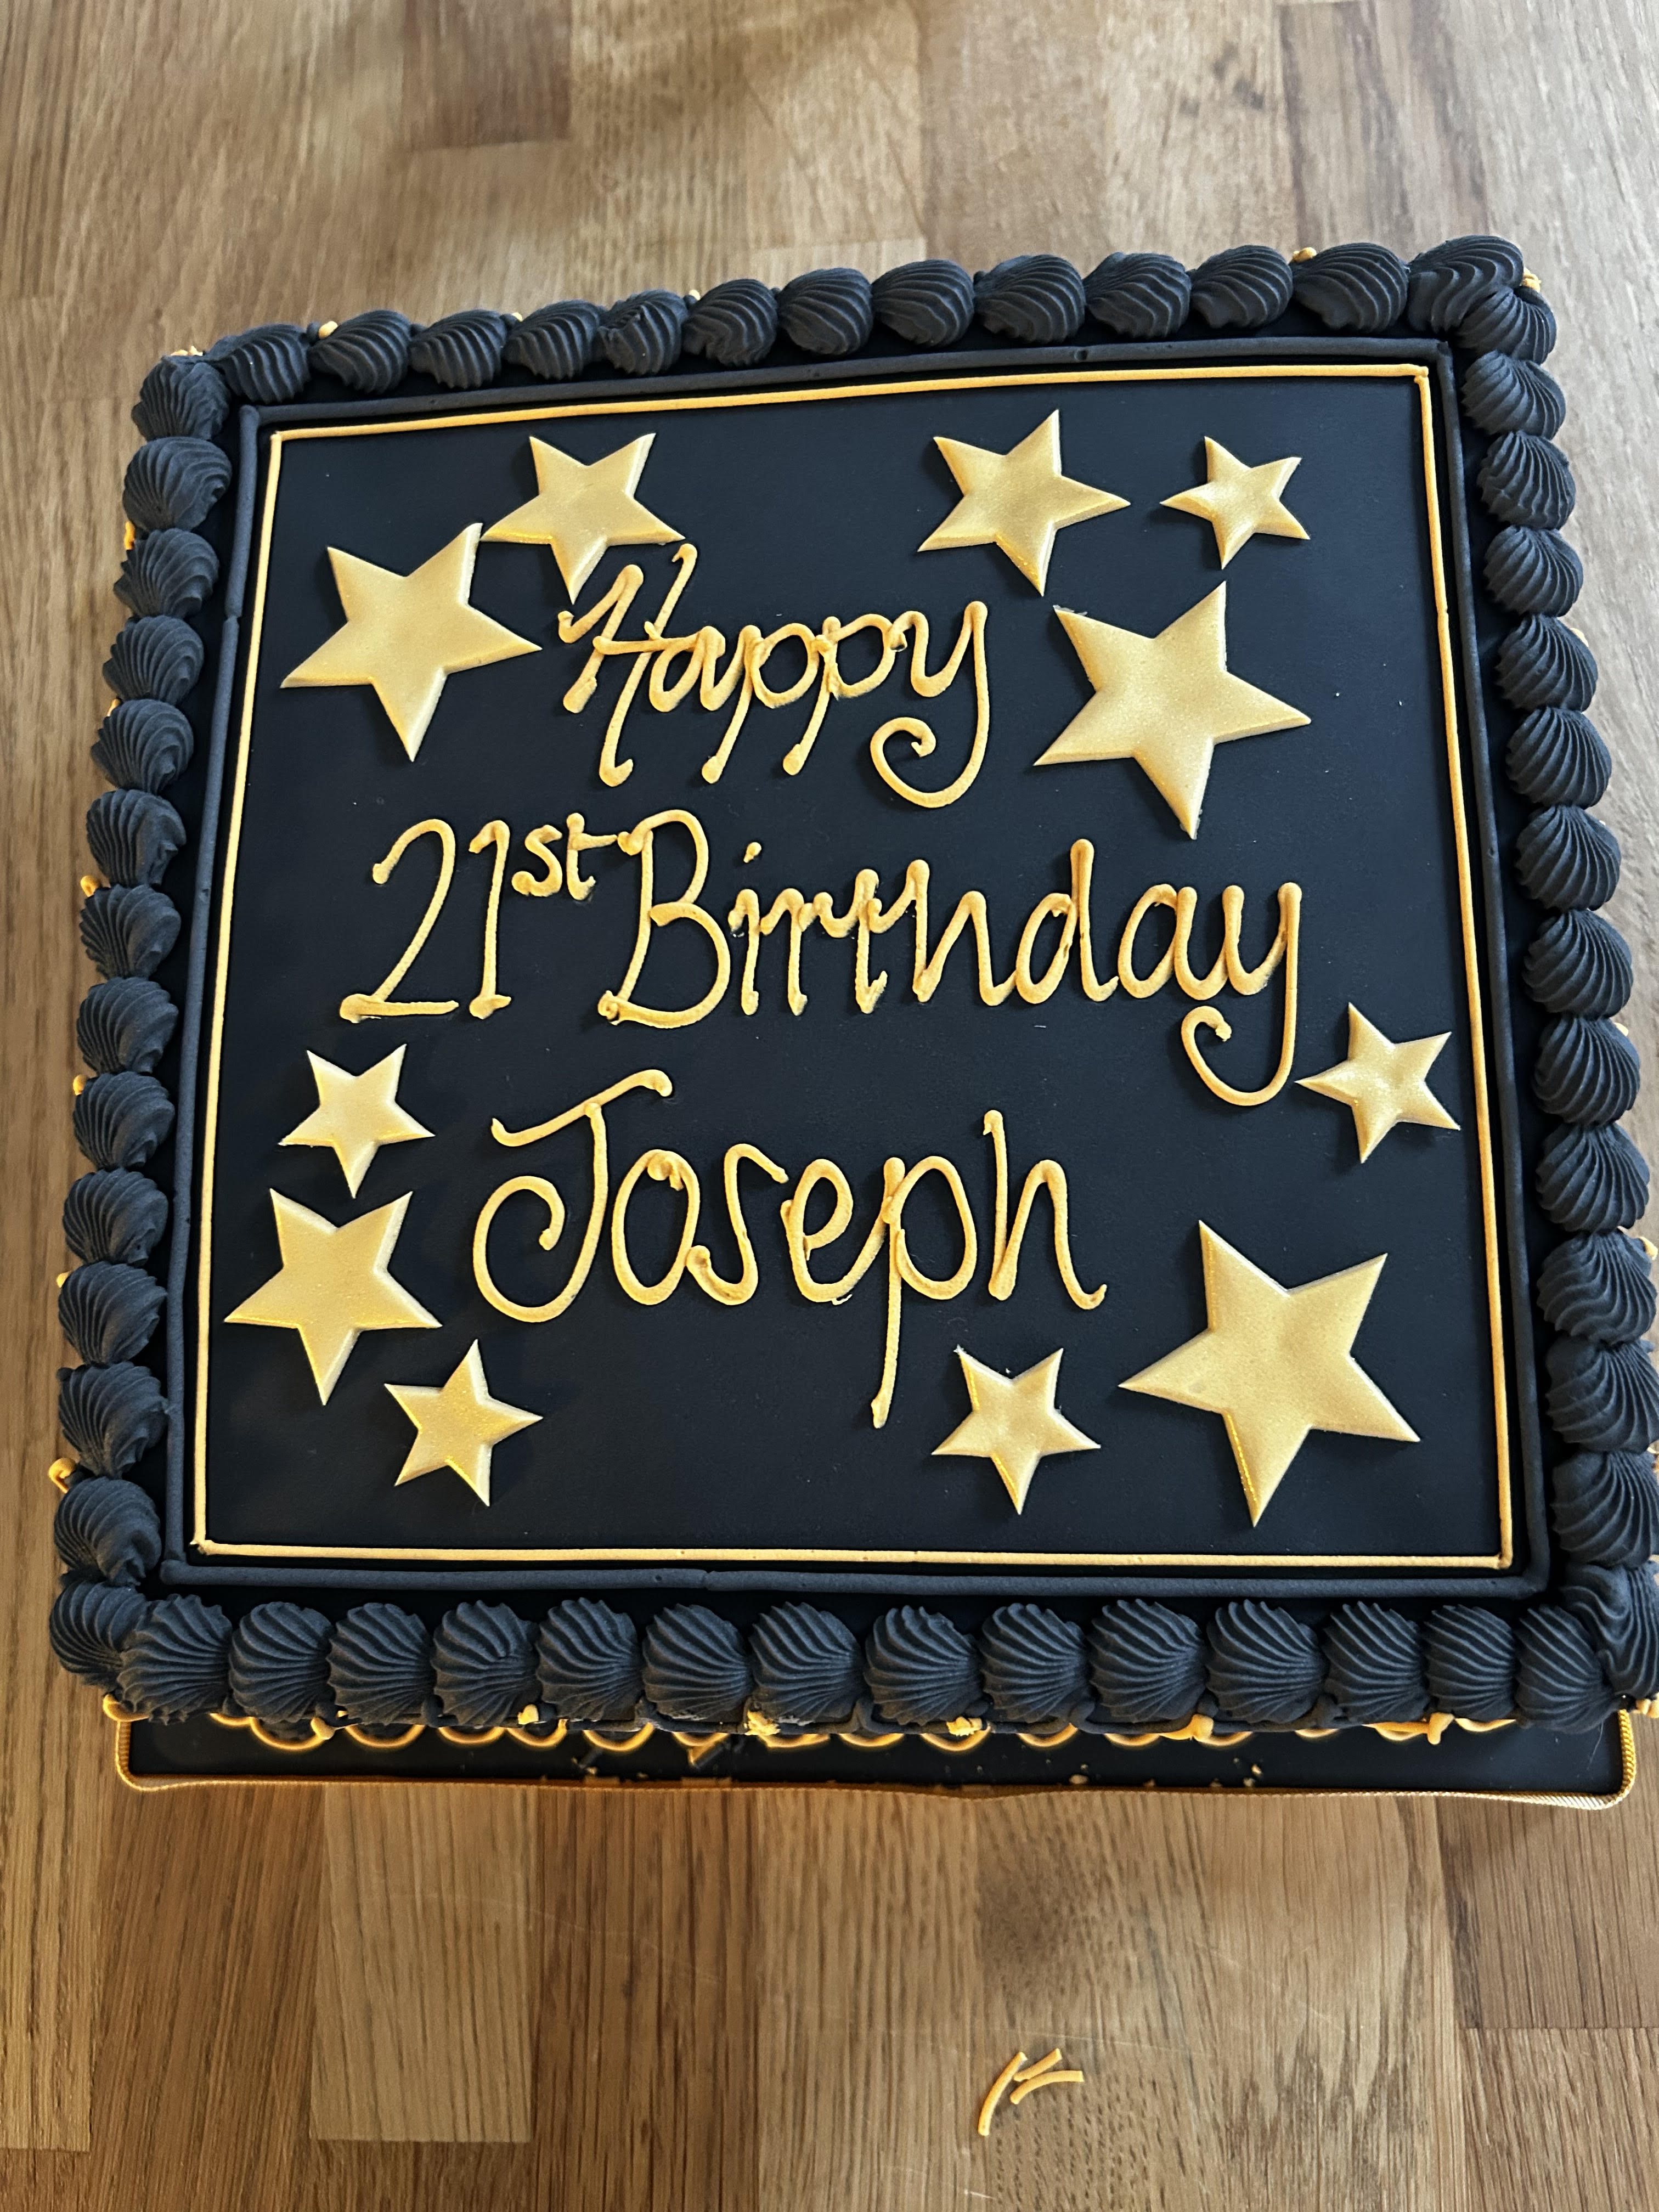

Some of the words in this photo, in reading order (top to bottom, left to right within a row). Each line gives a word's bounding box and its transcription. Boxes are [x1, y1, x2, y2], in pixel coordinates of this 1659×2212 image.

[558, 543, 990, 808] Happy
[339, 812, 618, 1024] 21st
[597, 809, 1302, 1107] Birthday
[472, 1069, 1107, 1429] Joseph
